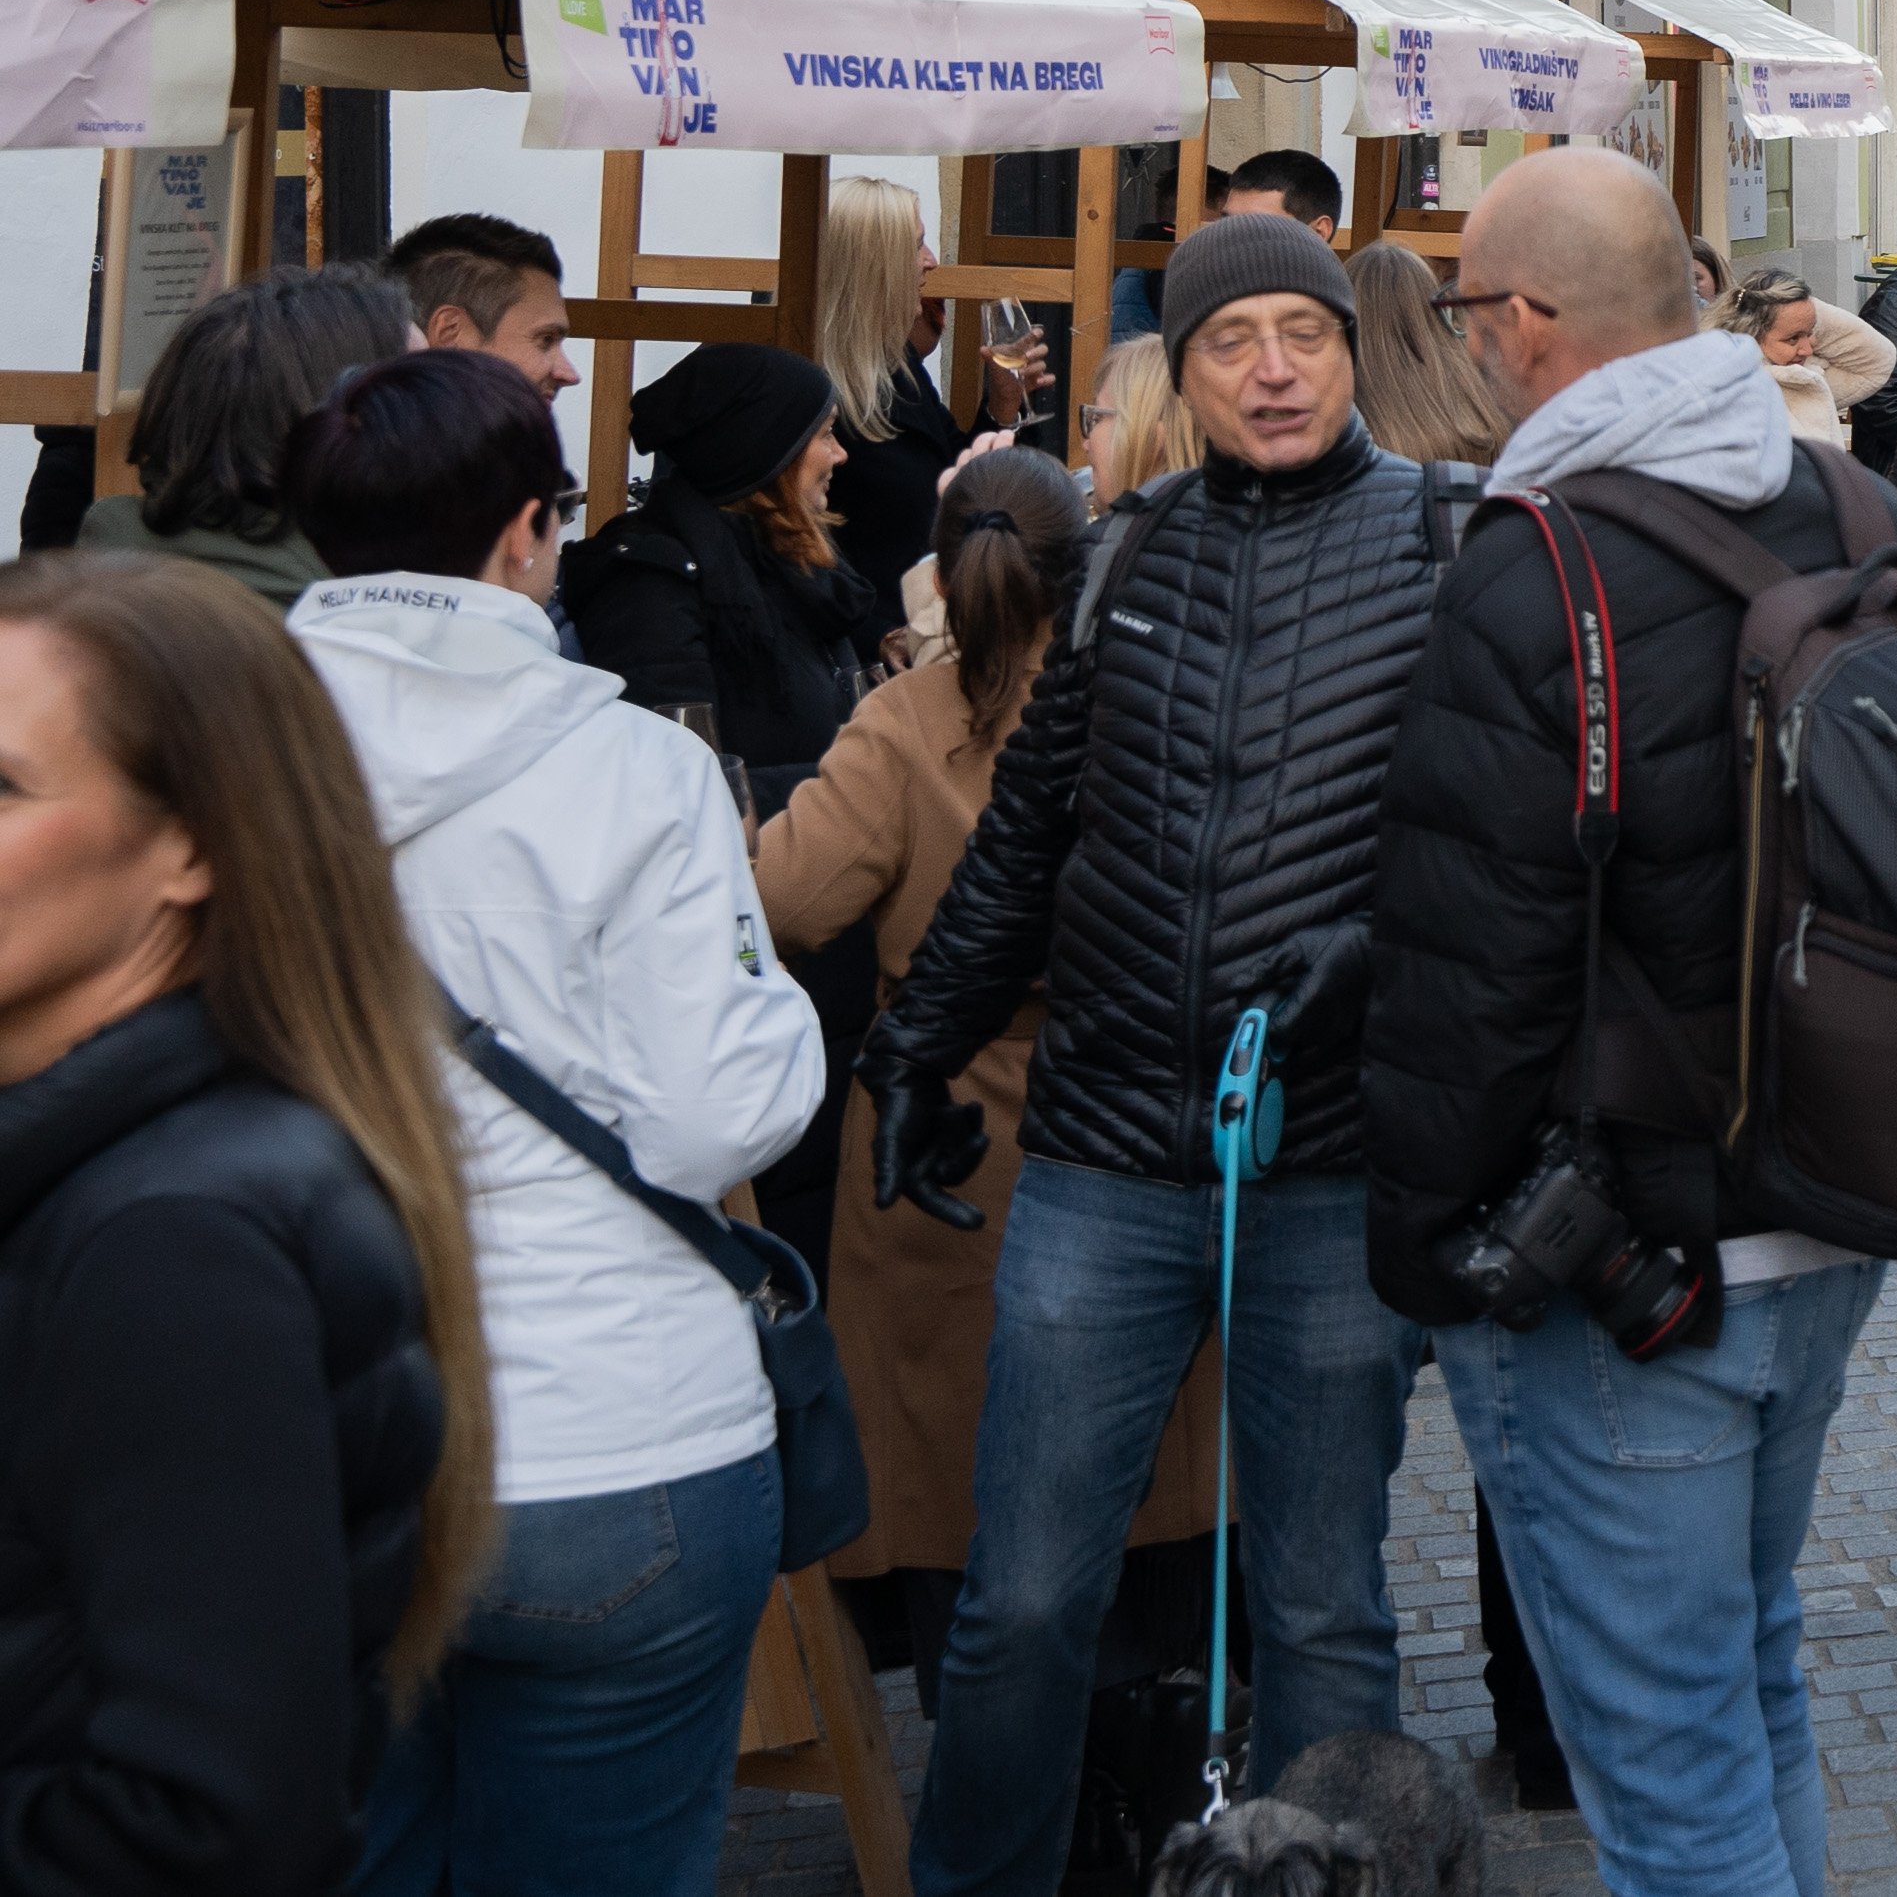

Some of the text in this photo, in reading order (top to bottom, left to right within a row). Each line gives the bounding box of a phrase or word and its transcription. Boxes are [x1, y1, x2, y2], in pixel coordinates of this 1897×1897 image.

[1400, 29, 1432, 50] MAR
[783, 52, 1104, 91] VINSKA KLET NA BREGI
[1479, 47, 1579, 80] VINOGRADNIŠTVO
[683, 103, 718, 133] JE
[1417, 101, 1433, 120] JE
[168, 155, 208, 167] MAR
[159, 169, 199, 181] TINO
[163, 182, 201, 195] VAN
[319, 586, 462, 613] HELLY HANSEN
[1588, 724, 1606, 795] EOS
